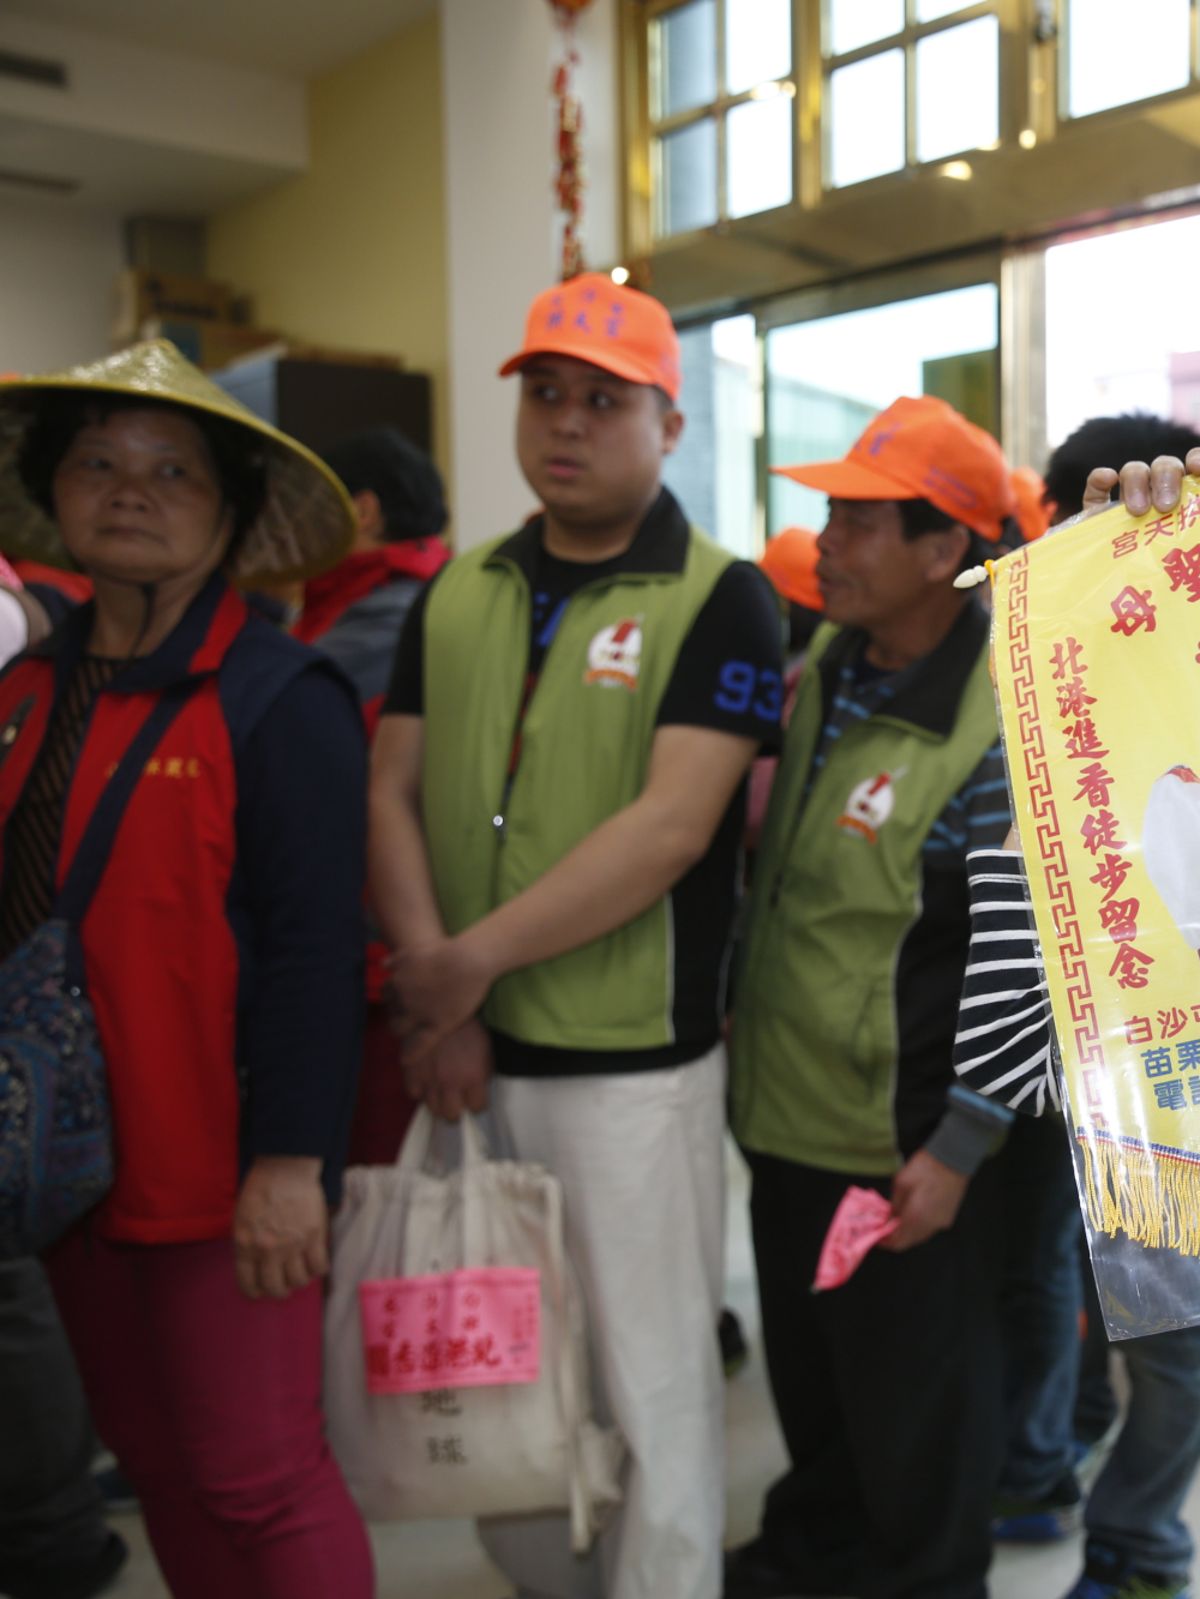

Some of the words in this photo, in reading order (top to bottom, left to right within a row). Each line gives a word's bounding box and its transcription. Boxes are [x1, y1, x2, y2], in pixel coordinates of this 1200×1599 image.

[714, 658, 784, 722] 93
[1049, 636, 1155, 989] 北港進香徒步留念
